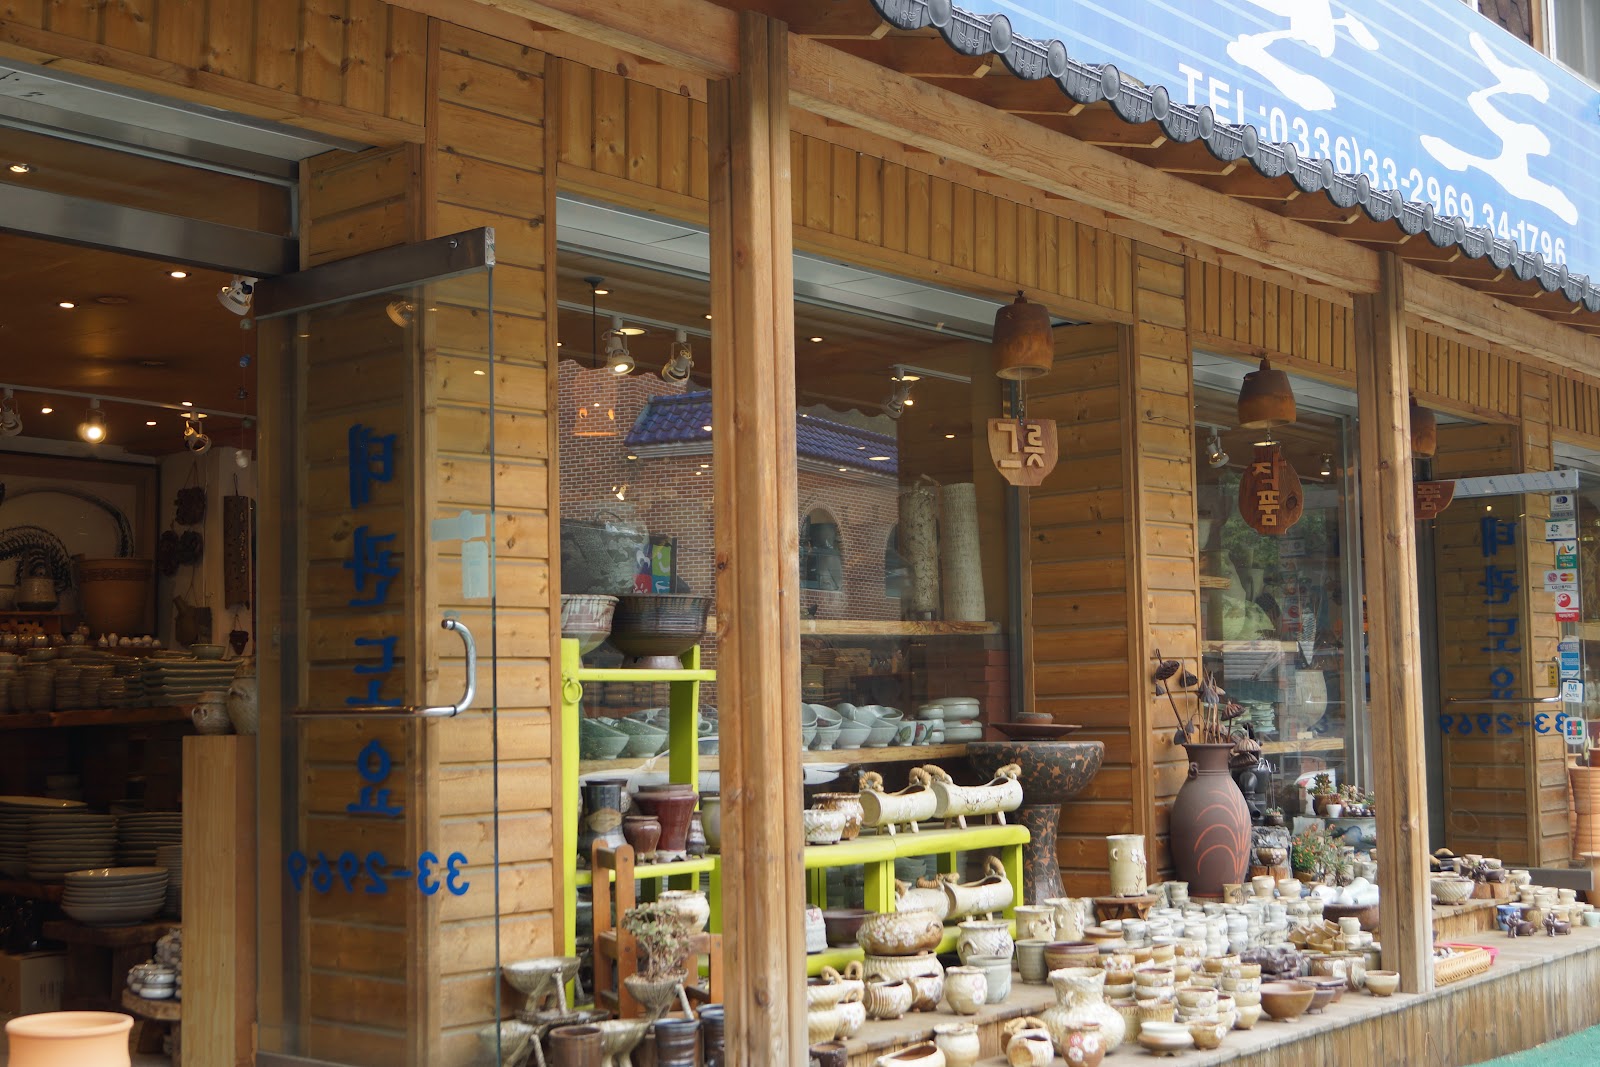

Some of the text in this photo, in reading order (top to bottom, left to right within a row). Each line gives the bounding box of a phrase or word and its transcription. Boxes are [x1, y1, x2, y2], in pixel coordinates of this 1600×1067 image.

[995, 422, 1046, 469] 그릇
[1251, 451, 1288, 526] 작품
[1416, 484, 1441, 511] 품
